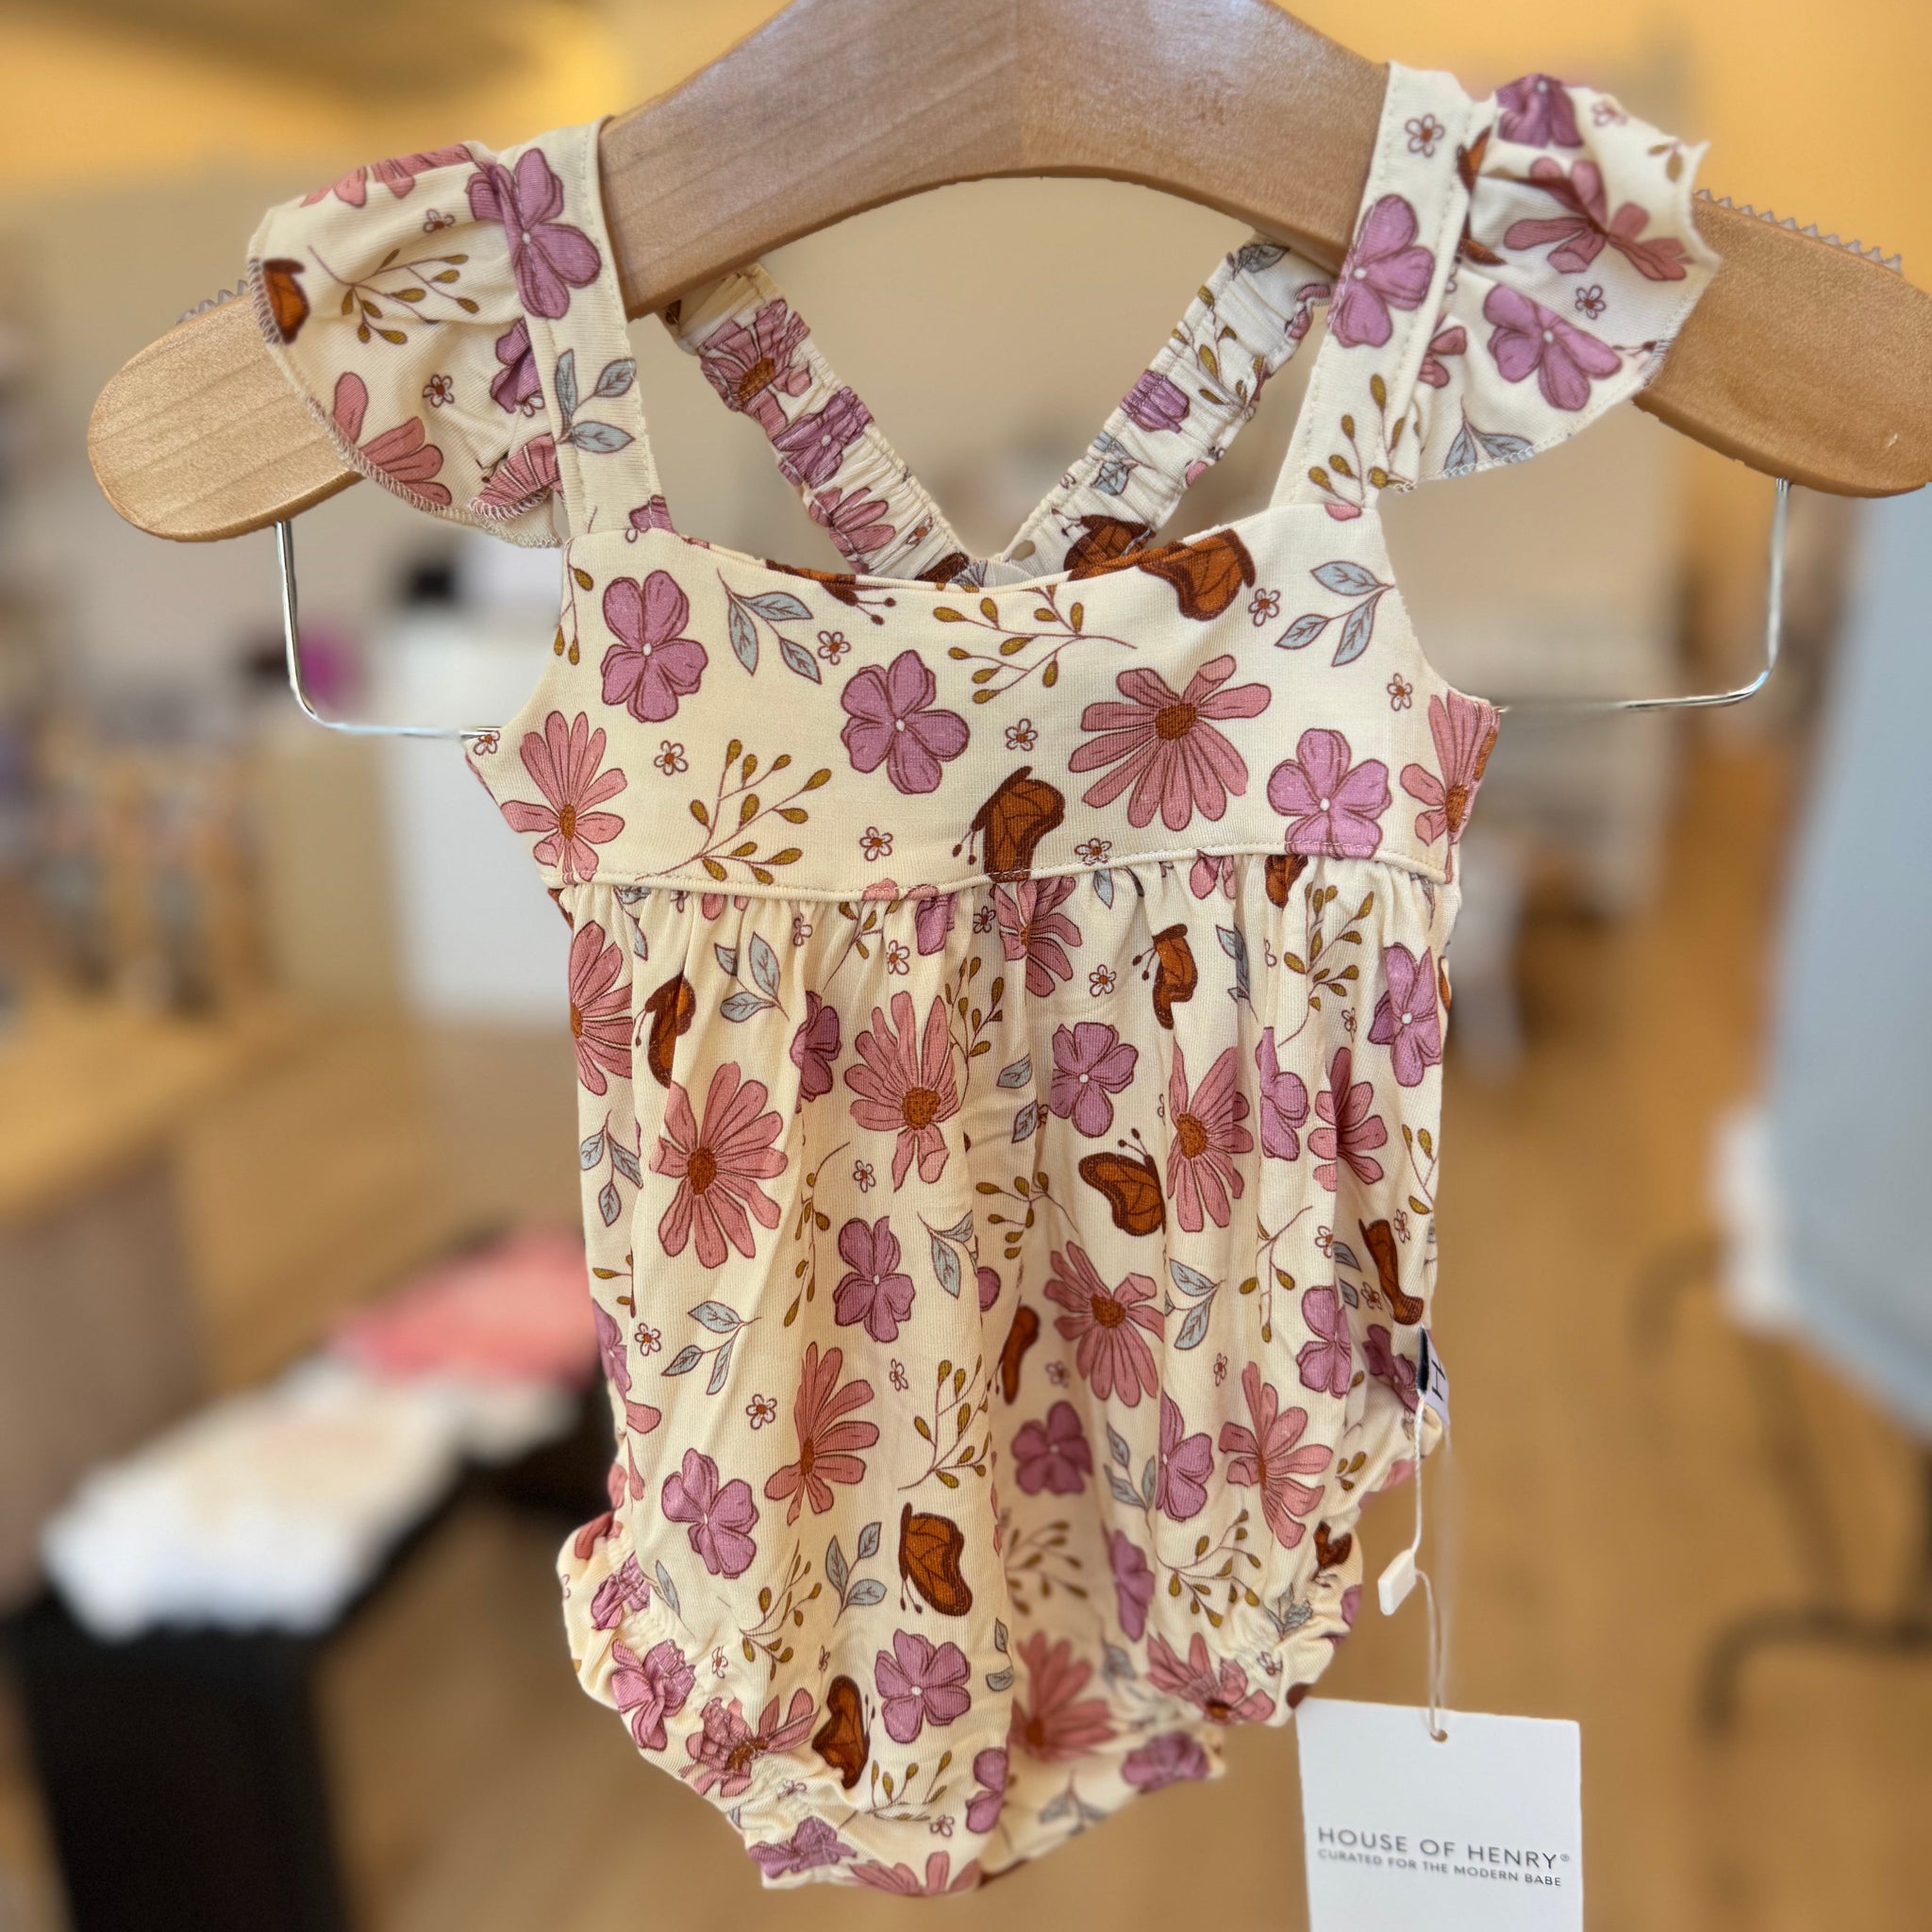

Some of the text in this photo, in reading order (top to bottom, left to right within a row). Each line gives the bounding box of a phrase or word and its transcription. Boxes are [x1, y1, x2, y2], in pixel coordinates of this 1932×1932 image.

[1318, 1826, 1407, 1853] HOUSE
[1420, 1839, 1457, 1857] OF
[1317, 1848, 1562, 1887] CURATED FOR THE MODERN BABE
